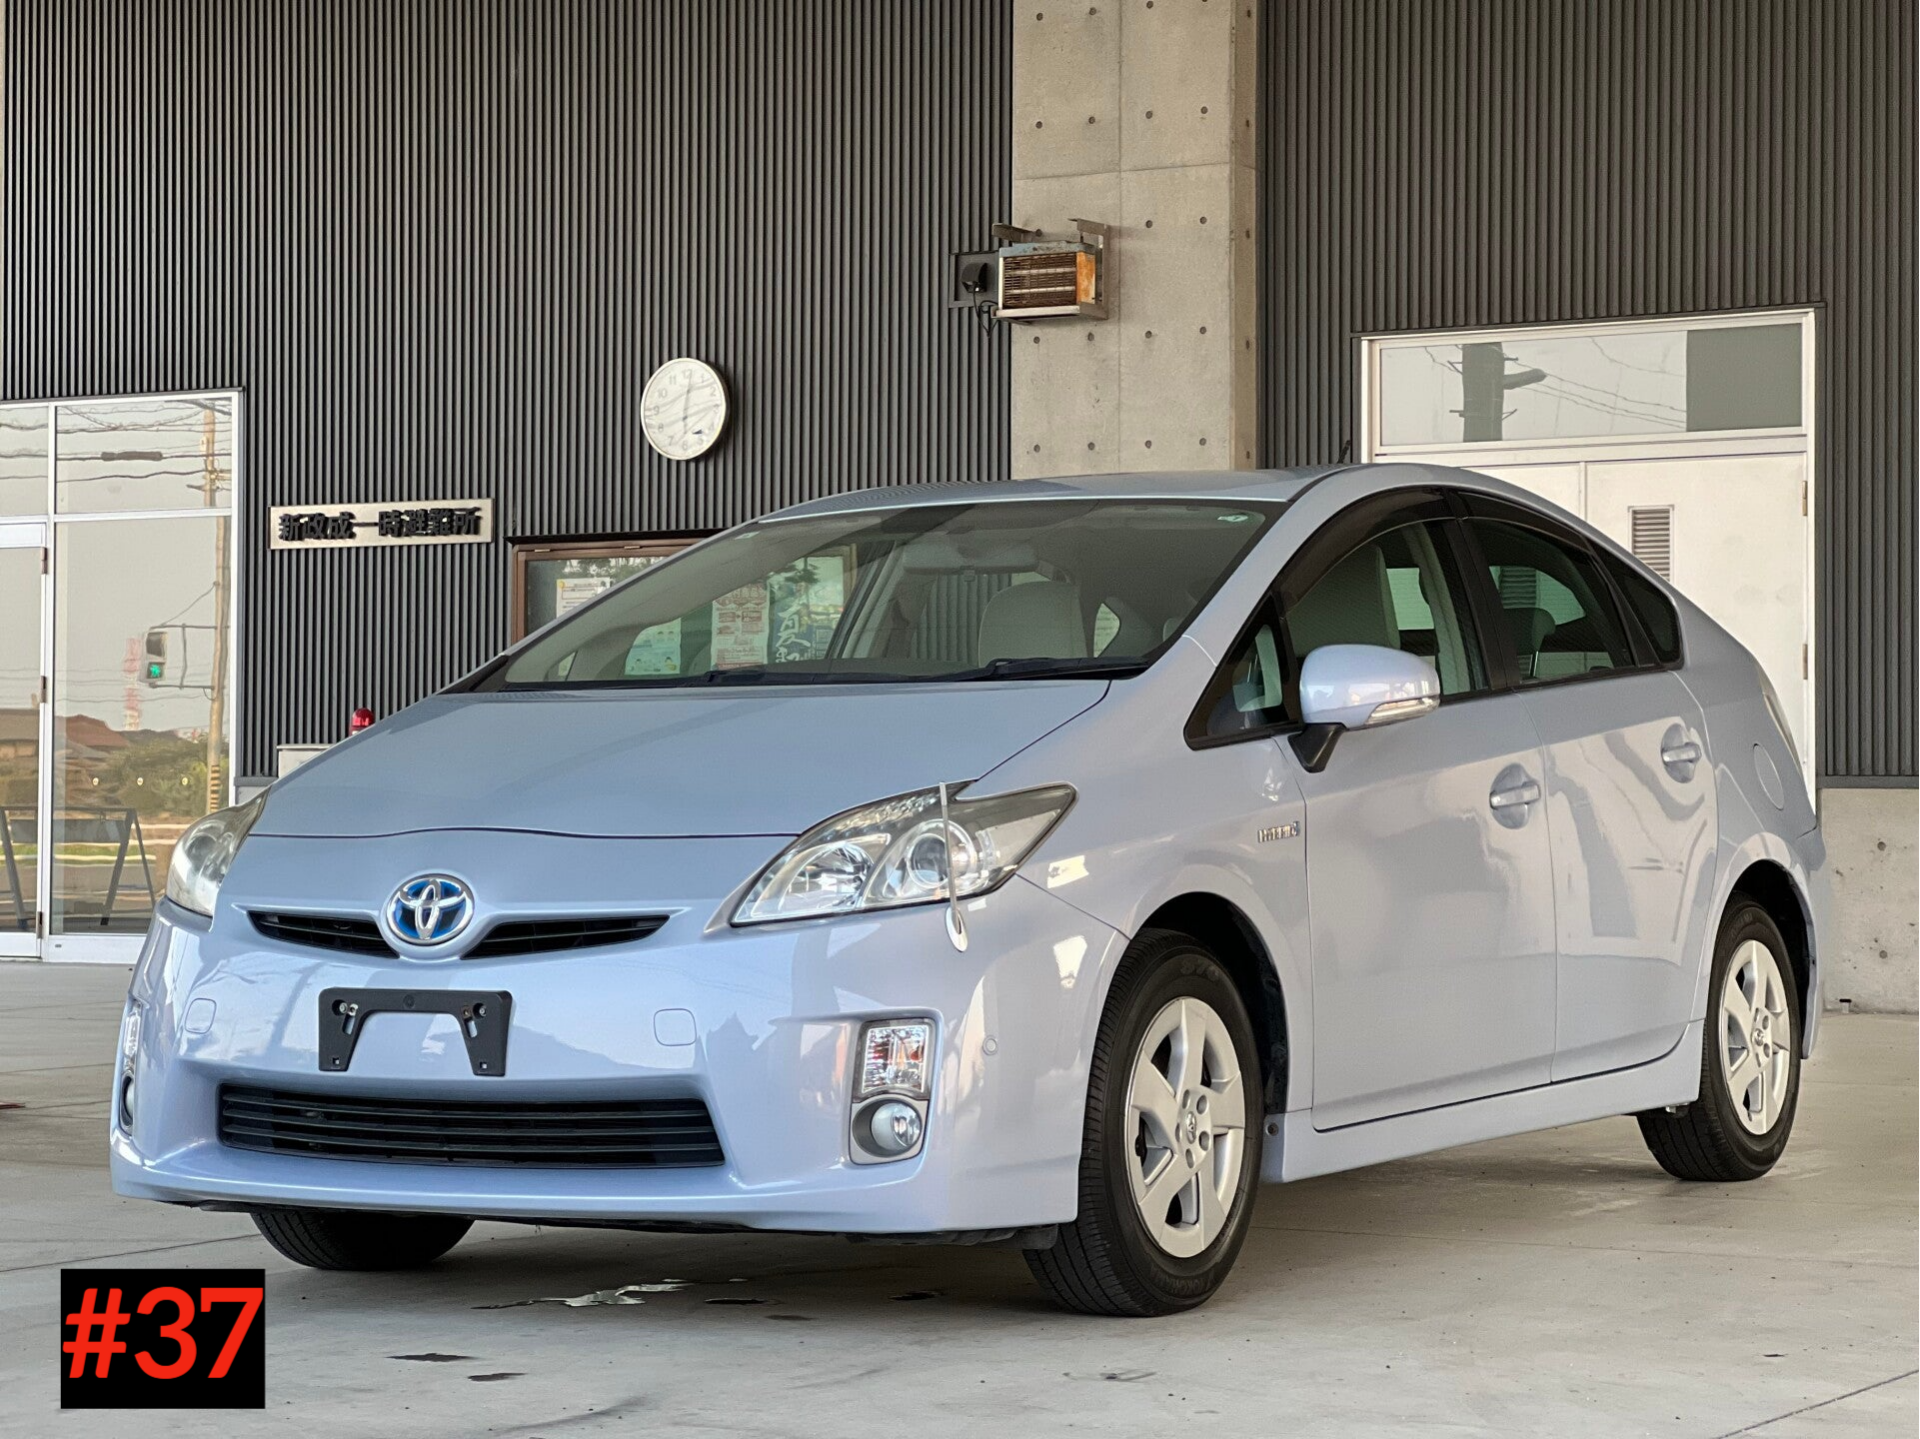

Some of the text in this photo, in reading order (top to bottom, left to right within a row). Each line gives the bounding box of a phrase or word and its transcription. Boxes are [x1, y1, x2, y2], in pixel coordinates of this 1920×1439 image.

[669, 375, 677, 386] 11
[657, 387, 668, 399] 10
[709, 386, 717, 397] 2
[653, 405, 660, 416] 9
[667, 435, 675, 446] 7
[681, 440, 688, 451] 6
[279, 506, 482, 541] 新政成一時避難所
